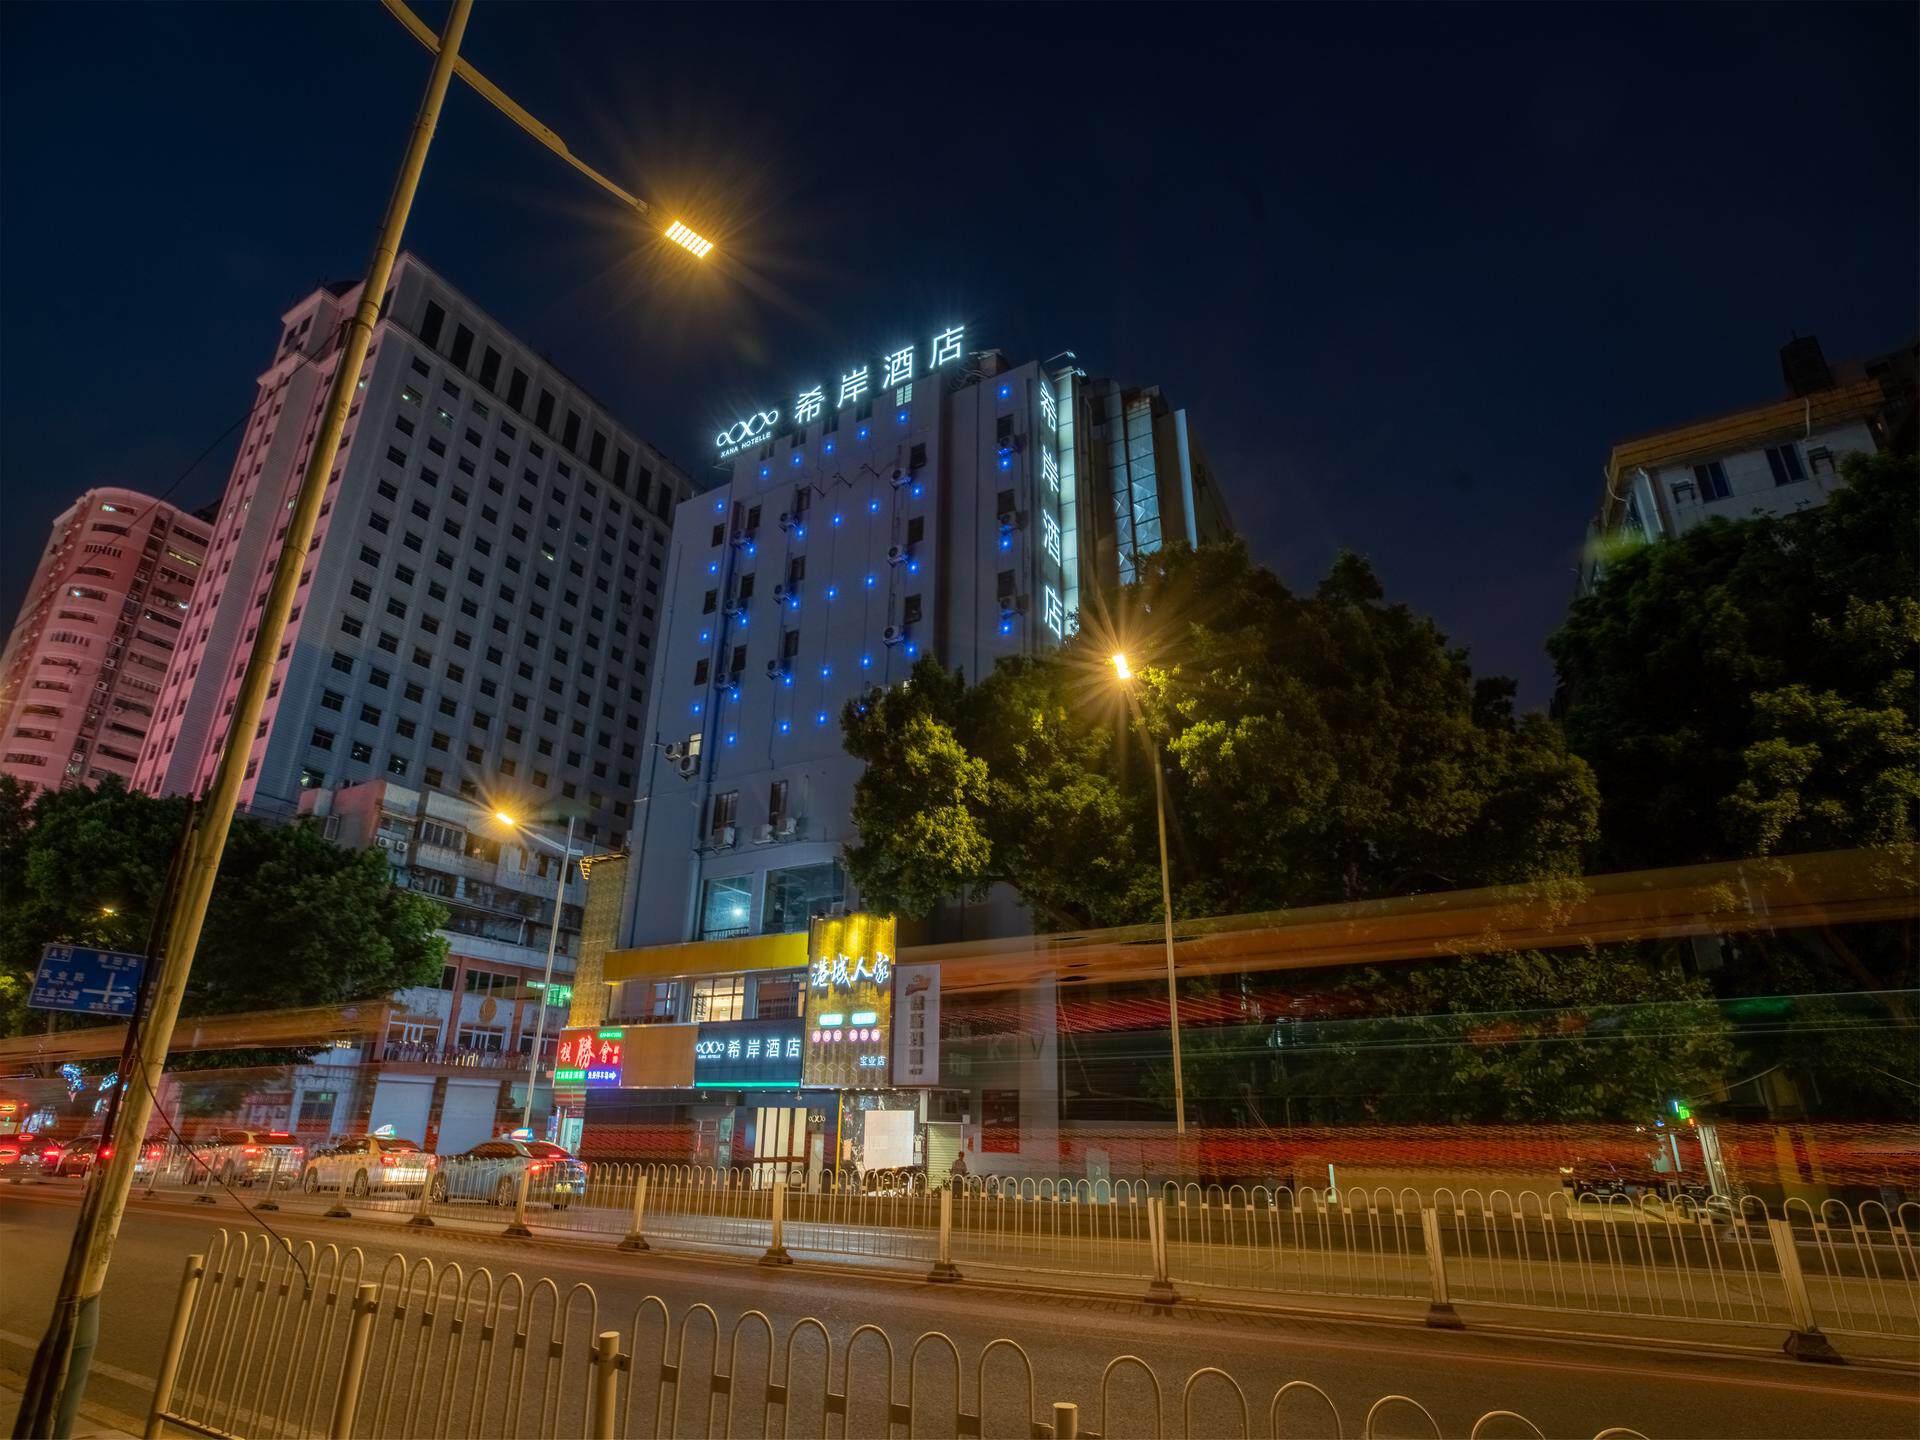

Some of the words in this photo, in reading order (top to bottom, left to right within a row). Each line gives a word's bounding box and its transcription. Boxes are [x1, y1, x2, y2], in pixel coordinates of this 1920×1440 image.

[794, 325, 965, 424] 希岸酒店
[721, 446, 739, 458] XANA
[741, 431, 771, 449] HOTELLE
[1040, 381, 1063, 640] 希岸酒店
[727, 1038, 801, 1059] 希岸酒店
